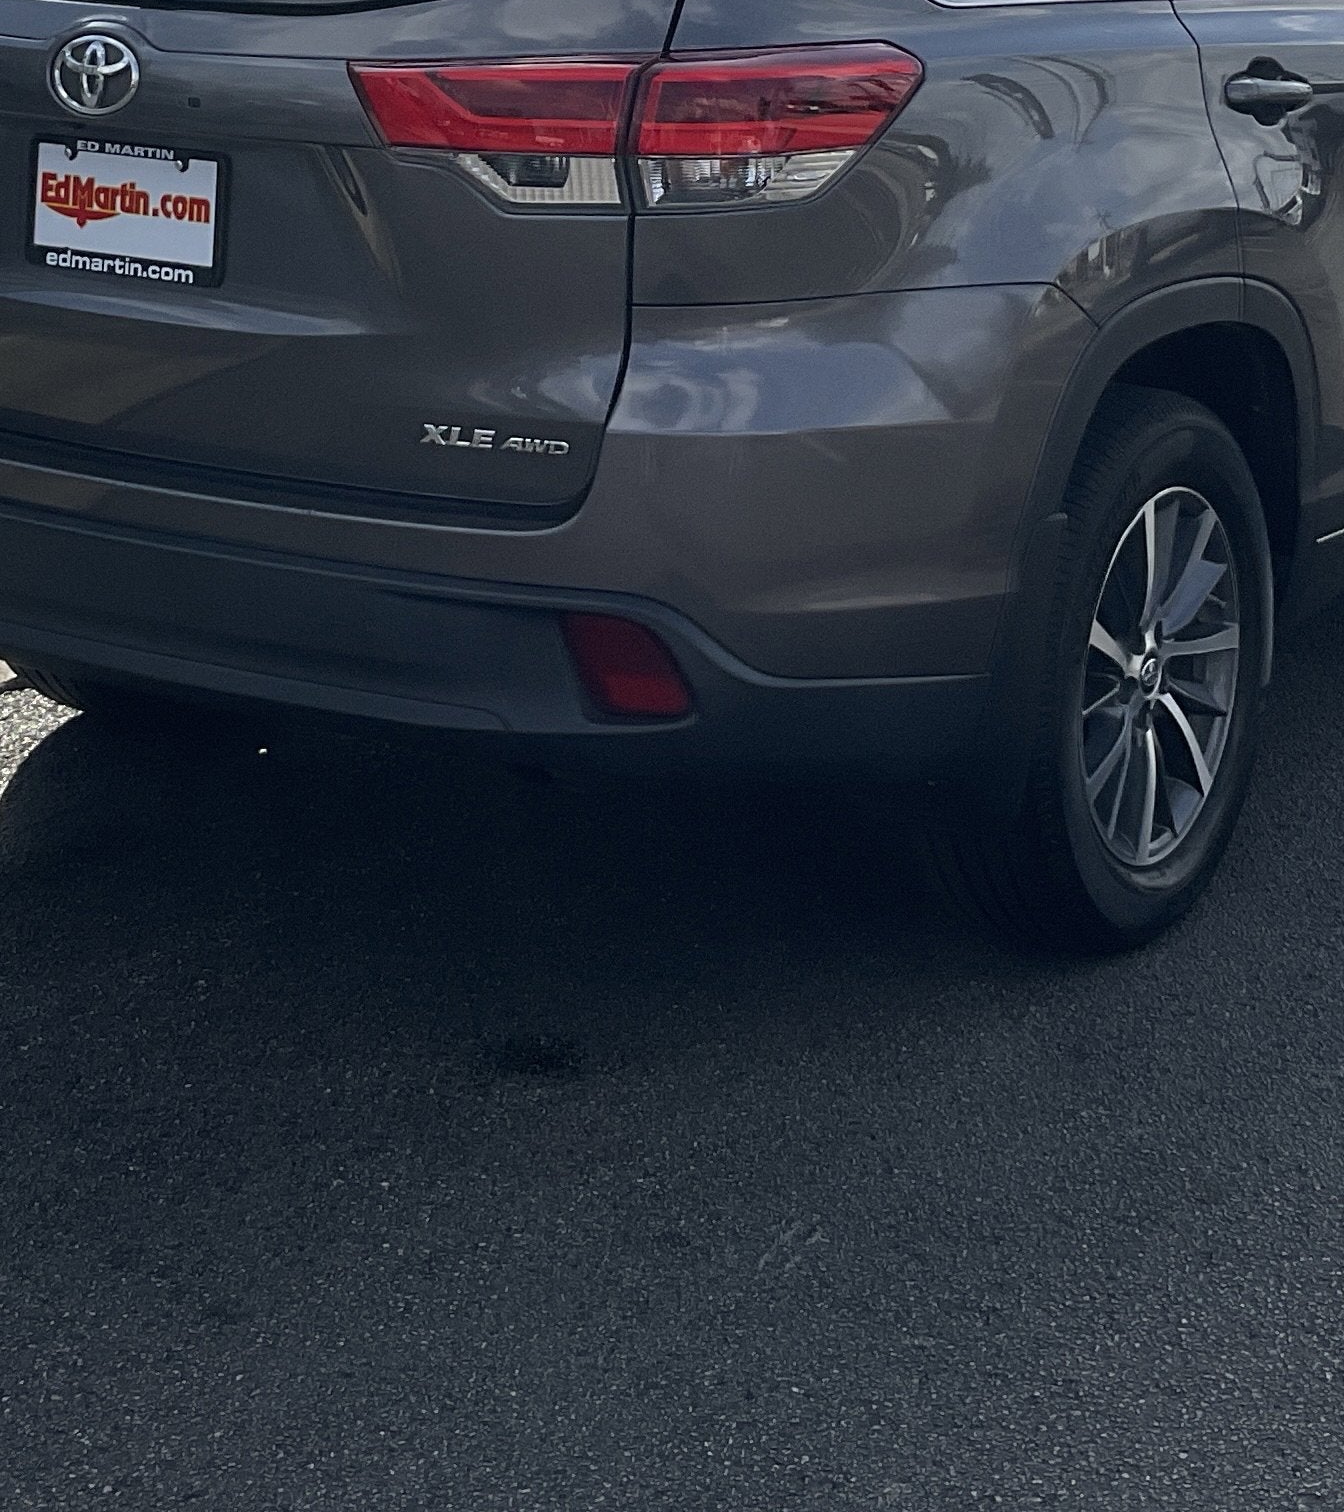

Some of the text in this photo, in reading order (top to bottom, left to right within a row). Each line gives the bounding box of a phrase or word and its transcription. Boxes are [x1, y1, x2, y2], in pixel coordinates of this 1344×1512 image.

[76, 140, 175, 160] ED MARTIN
[45, 250, 194, 284] edmartin.com
[420, 423, 570, 455] XLE AWD
